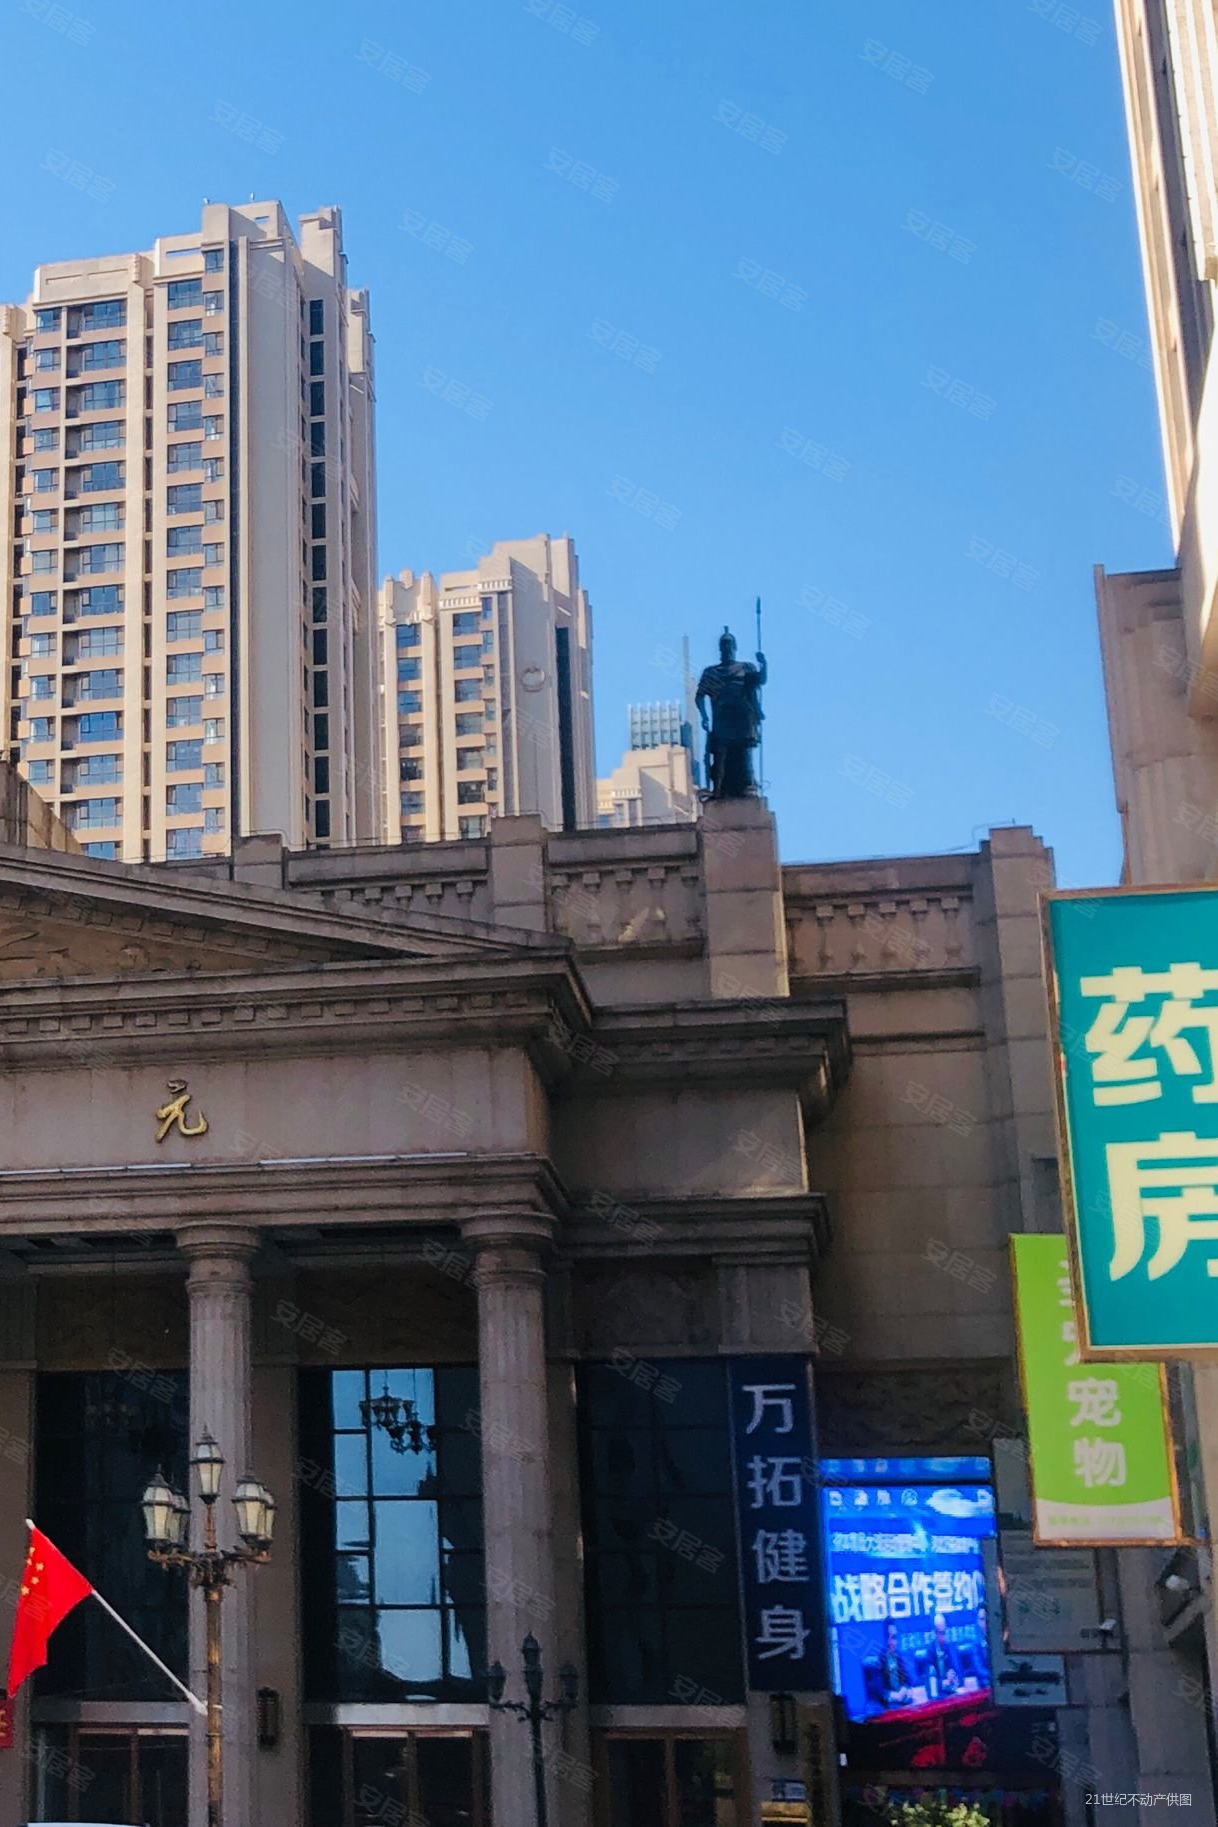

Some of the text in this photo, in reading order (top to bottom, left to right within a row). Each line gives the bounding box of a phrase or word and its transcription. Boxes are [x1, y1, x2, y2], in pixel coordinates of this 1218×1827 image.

[1080, 962, 1218, 1282] 药房
[1055, 1258, 1127, 1488] 宠物
[742, 1384, 811, 1661] 万拓健身
